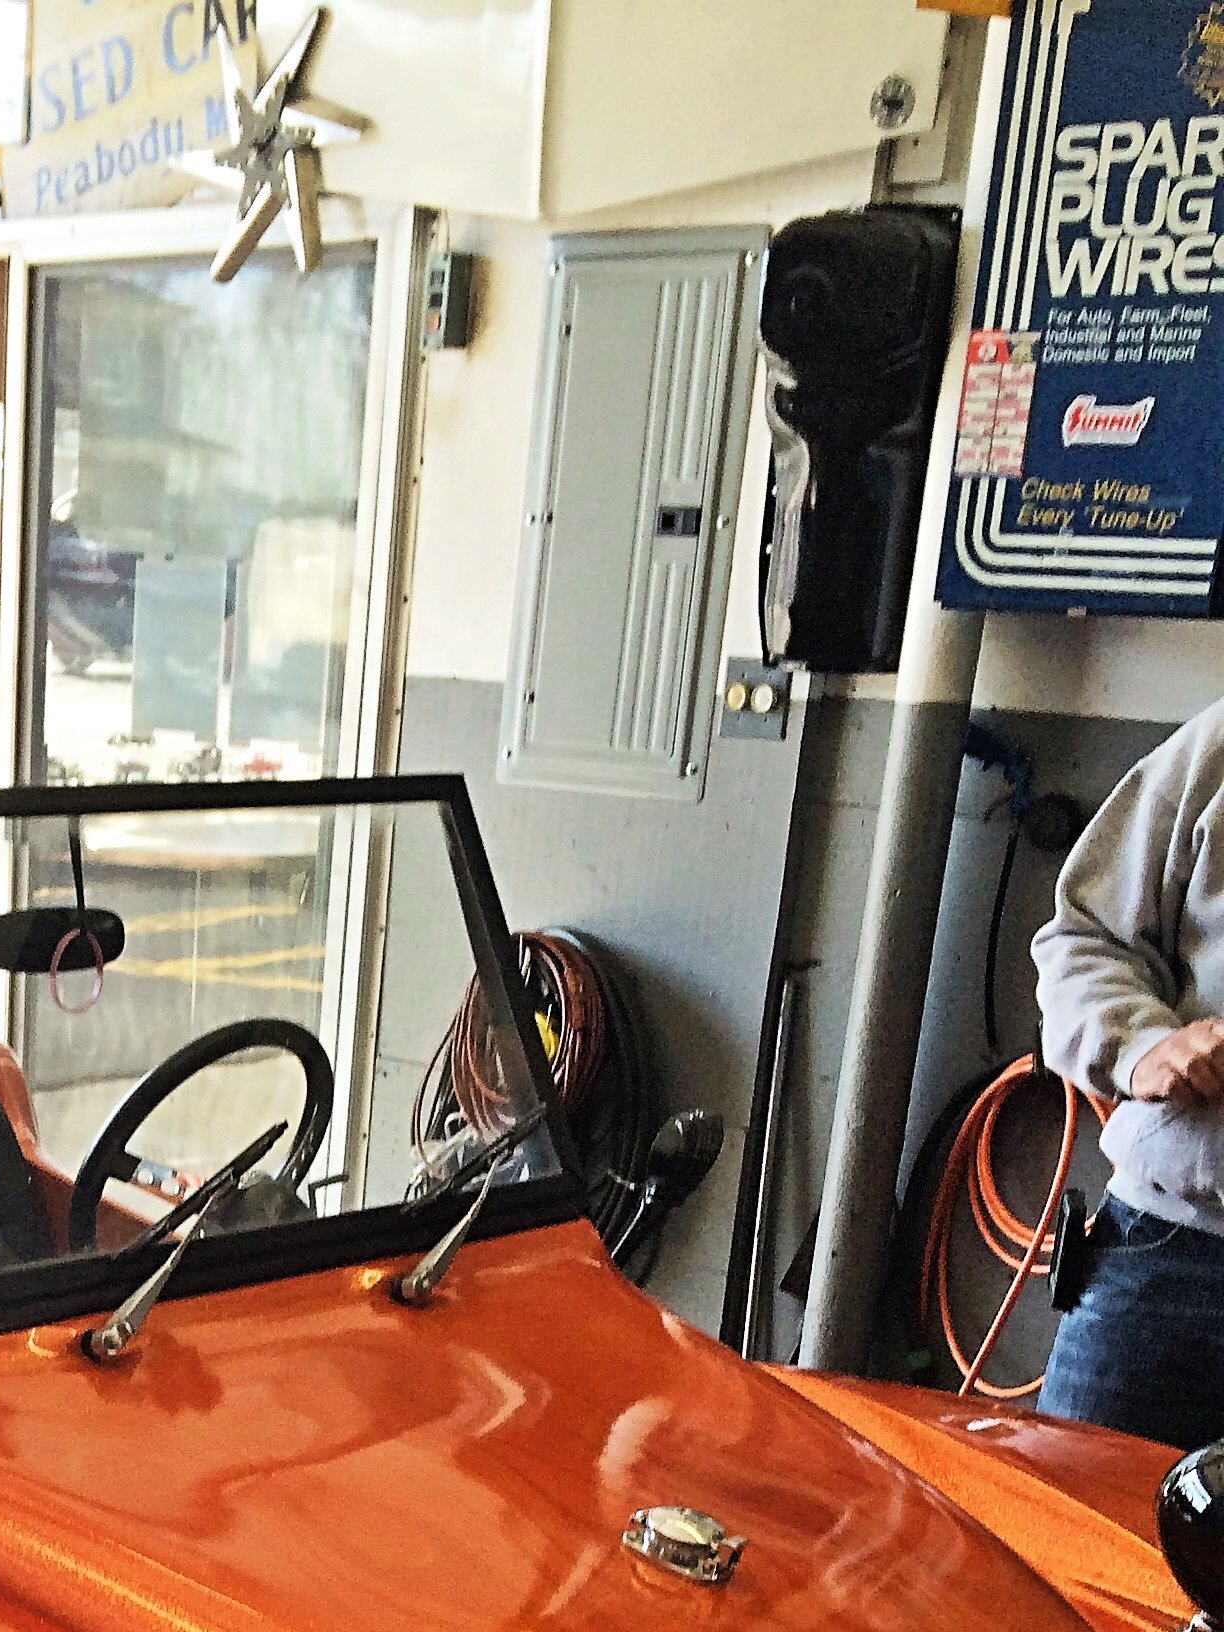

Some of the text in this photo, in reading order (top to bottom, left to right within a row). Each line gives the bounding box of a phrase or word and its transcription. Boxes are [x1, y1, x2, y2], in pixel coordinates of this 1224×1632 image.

[1046, 174, 1218, 242] PLUG
[1116, 326, 1146, 343] and
[1149, 325, 1202, 342] Marine
[1042, 343, 1197, 364] Domestic and Import
[1021, 476, 1151, 503] Check Wires
[1016, 502, 1075, 529] Every
